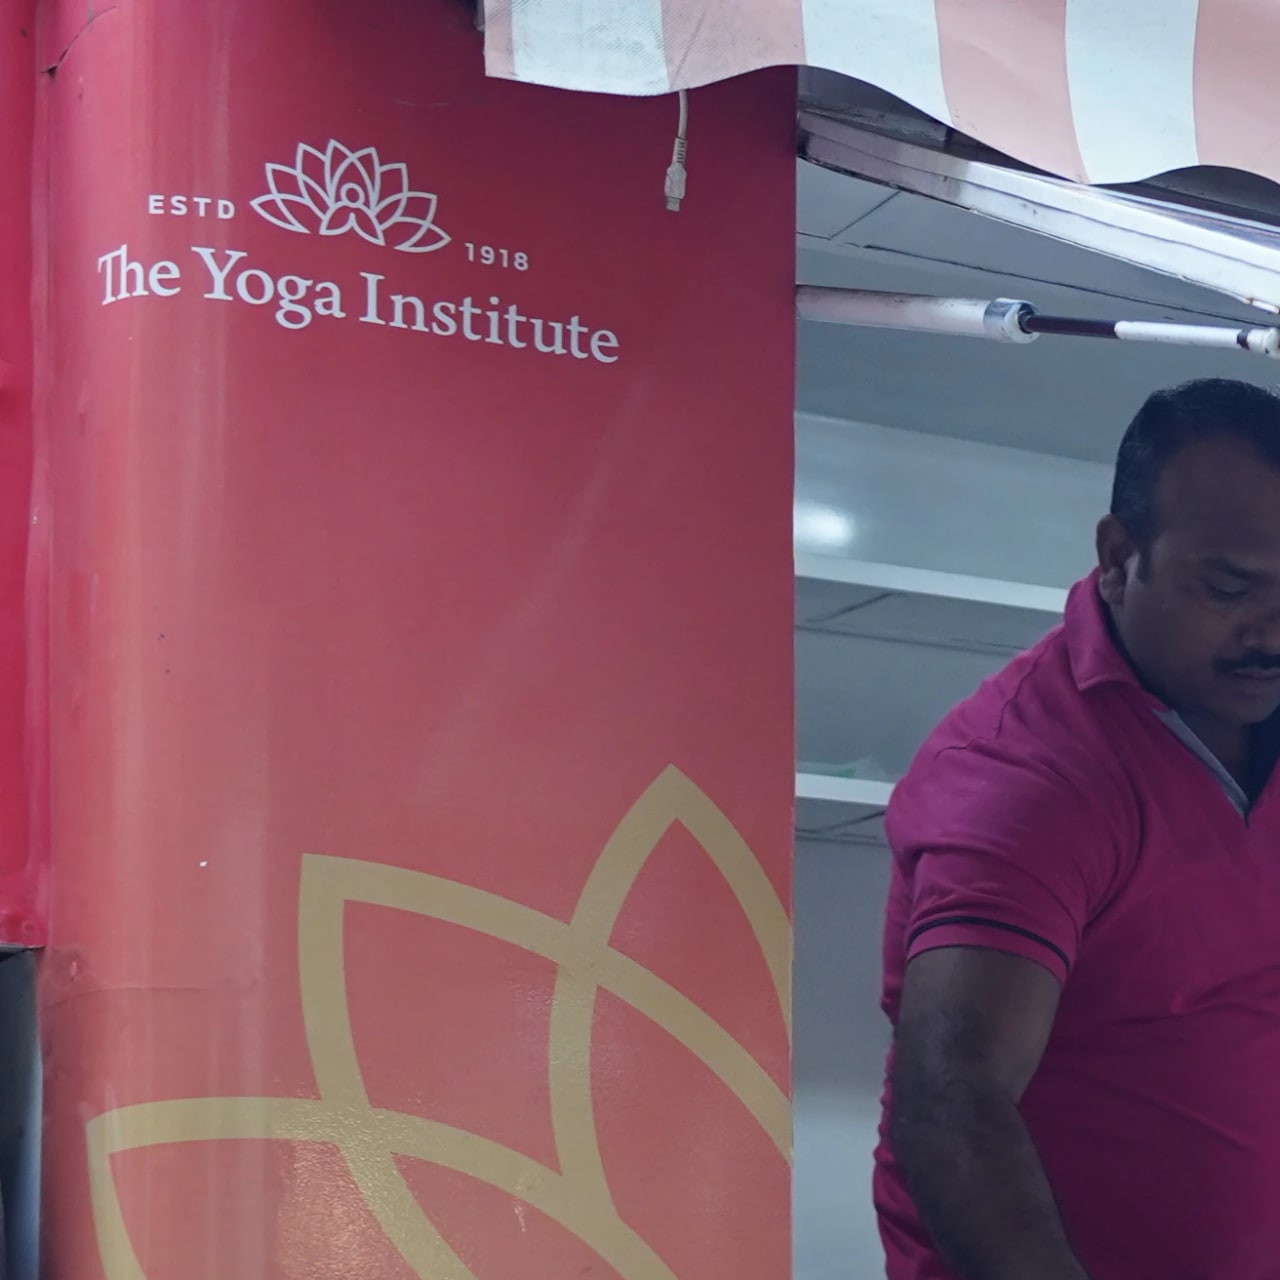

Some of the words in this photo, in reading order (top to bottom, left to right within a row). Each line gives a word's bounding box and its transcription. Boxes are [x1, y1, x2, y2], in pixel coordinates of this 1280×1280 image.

[148, 194, 235, 219] ESTD
[464, 242, 530, 271] 1918
[97, 244, 182, 306] The
[190, 246, 347, 329] Yoga
[359, 271, 620, 363] Institute
